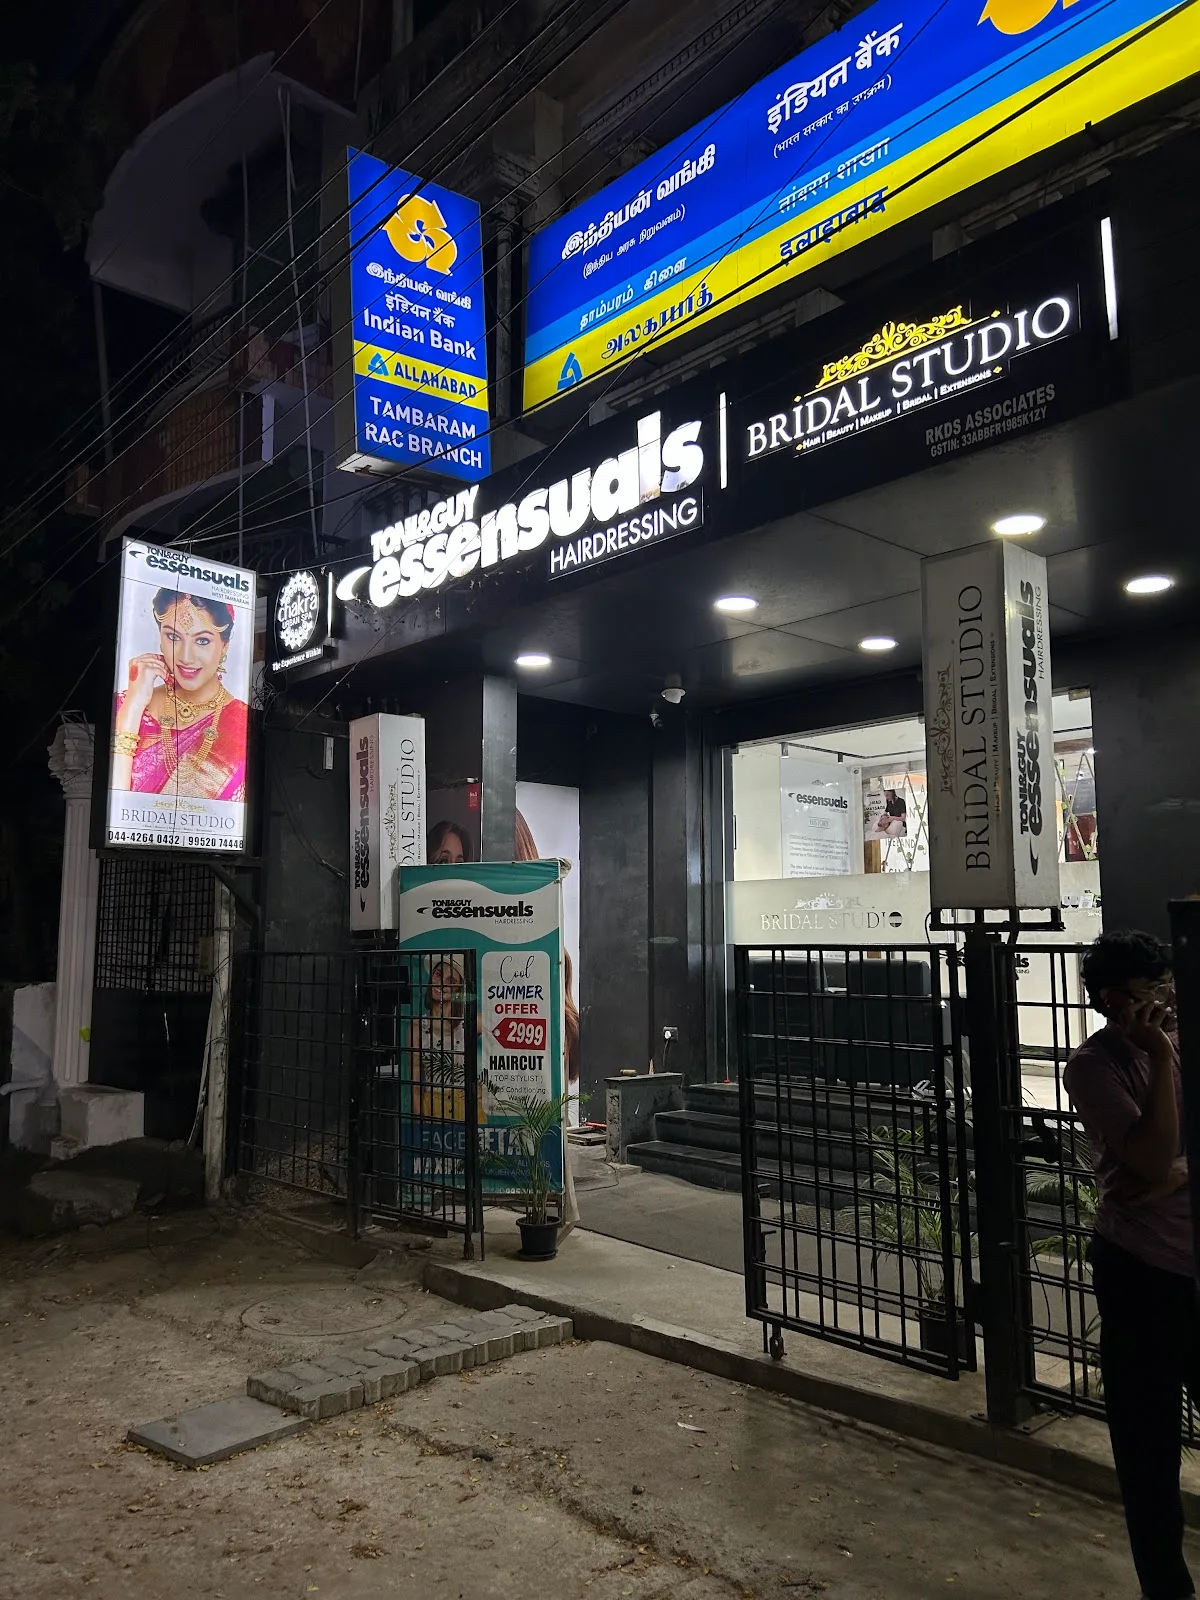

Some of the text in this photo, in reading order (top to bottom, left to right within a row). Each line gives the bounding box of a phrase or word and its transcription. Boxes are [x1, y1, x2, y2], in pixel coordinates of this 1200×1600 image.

[767, 22, 903, 134] इंडियन बैंक
[561, 143, 716, 260] இந்தியன் வங்கி
[365, 261, 472, 310] இந்தியன் வங்கி
[579, 257, 687, 331] தாம்பரம் கிளை
[385, 291, 455, 329] इंडियन बैंक
[363, 307, 476, 360] Indian Bank
[394, 362, 477, 399] ALLAHABAD
[747, 297, 1071, 457] BRIDAL STUDIO
[370, 396, 476, 439] TAMBARAM
[925, 383, 1056, 445] RKDS ASSOCIATES
[365, 423, 482, 468] RAC BRANCH
[930, 438, 960, 458] GSTIN:
[368, 410, 704, 608] essensuals
[370, 484, 480, 562] TONI&GUY
[550, 498, 698, 575] HAIRDRESSING
[146, 554, 249, 592] essensuals
[278, 593, 318, 622] chakra
[1035, 586, 1045, 679] HAIRDRESSING
[958, 585, 991, 872] BRIDAL STUDIO
[1016, 580, 1043, 836] essensuals
[400, 739, 415, 822] STUDIO
[796, 793, 848, 809] essensuals
[1017, 727, 1029, 835] TONI&GUY
[121, 808, 176, 825] BRIDAL
[180, 813, 235, 829] STUDIO
[356, 736, 370, 888] essensuals
[108, 830, 244, 849] 044-4264 0432 99520 74448
[431, 901, 534, 918] essensuals
[761, 913, 823, 930] BRIDAL
[500, 955, 535, 984] Cool
[487, 985, 544, 1000] SUMMER
[494, 1003, 539, 1014] OFFER
[506, 1021, 544, 1046] 2999
[489, 1055, 545, 1070] HAIRCUT
